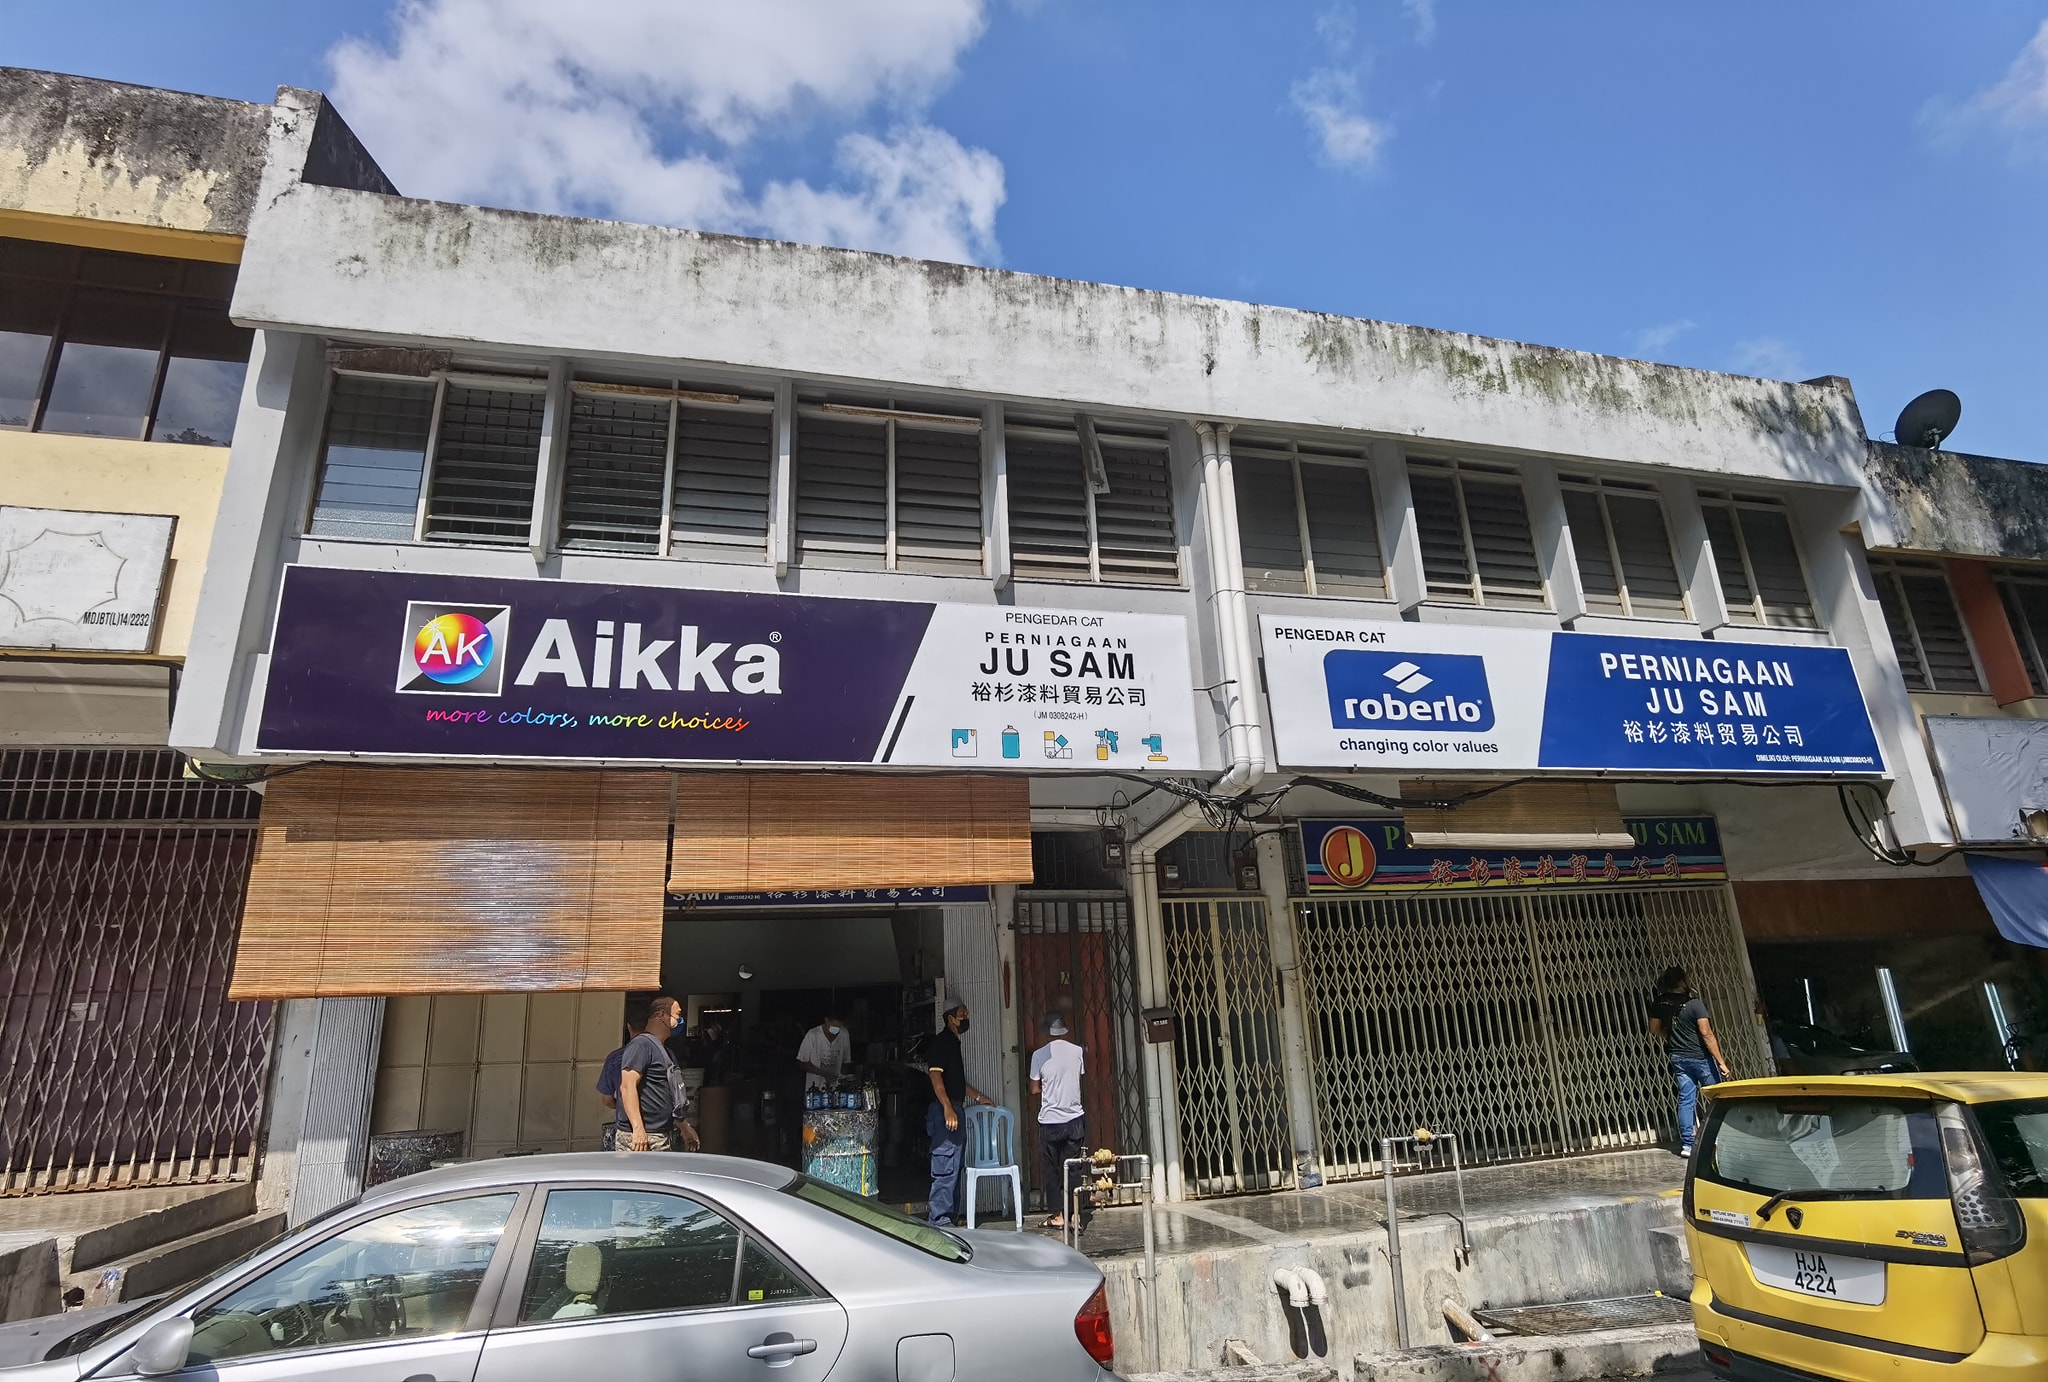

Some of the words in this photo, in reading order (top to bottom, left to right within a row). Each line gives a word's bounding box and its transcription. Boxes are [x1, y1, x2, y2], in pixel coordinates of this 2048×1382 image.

[1005, 613, 1078, 627] PENGEDAR
[1081, 616, 1104, 627] CAT
[985, 632, 1128, 649] PERNIAGAAN
[1275, 627, 1355, 642] PENGEDAR
[1359, 631, 1386, 644] CAT
[420, 631, 489, 667] AK
[980, 647, 1029, 676] JU
[1050, 650, 1135, 680] SAM
[1600, 653, 1794, 687] PERNIAGAAN
[971, 681, 1147, 707] 裕杉漆料貿易公司
[1646, 687, 1685, 715] JU
[1700, 689, 1768, 717] SAM
[426, 708, 492, 724] more
[498, 706, 579, 729] colors,
[589, 712, 654, 729] more
[658, 711, 750, 733] choices
[1344, 694, 1481, 723] roberlo
[1339, 738, 1409, 754] changing
[1412, 740, 1449, 752] color
[1452, 741, 1499, 753] values
[1623, 719, 1804, 747] 裕杉漆料贸易公司
[1656, 822, 1707, 846] SAM
[1794, 1252, 1828, 1274] HJA
[1794, 1272, 1837, 1295] 4224
